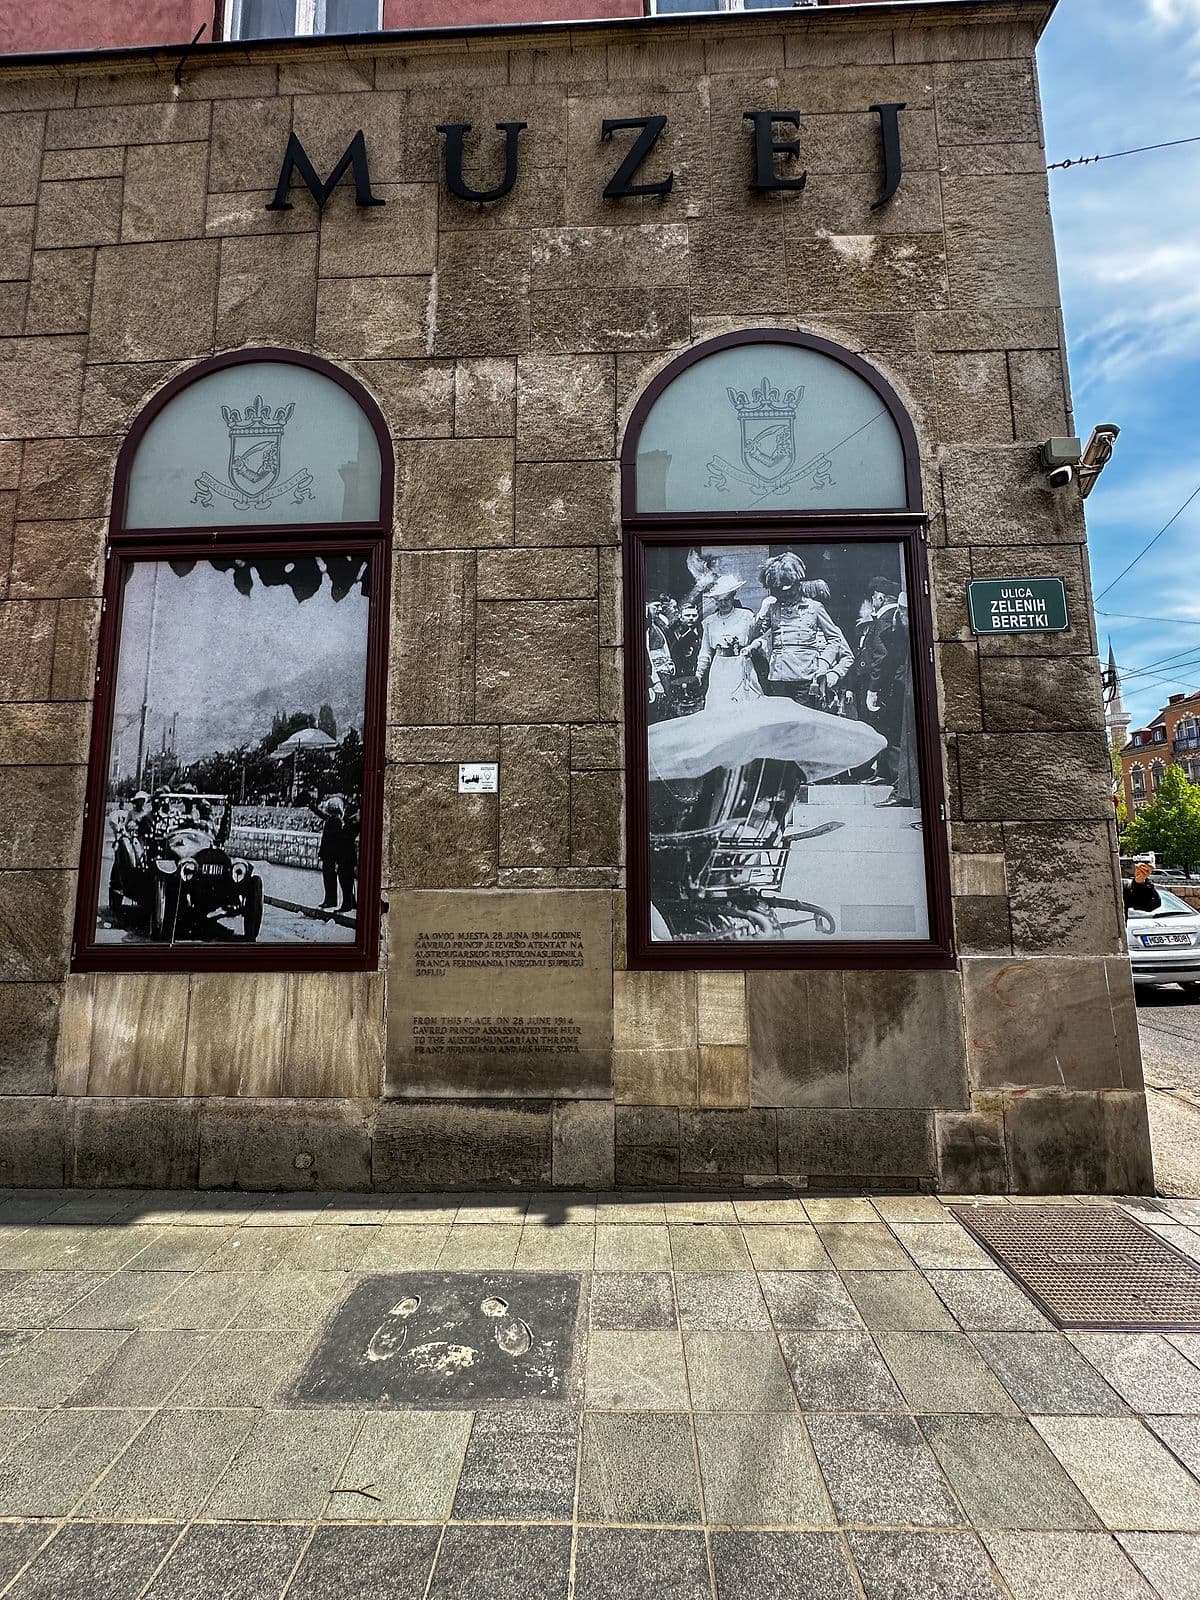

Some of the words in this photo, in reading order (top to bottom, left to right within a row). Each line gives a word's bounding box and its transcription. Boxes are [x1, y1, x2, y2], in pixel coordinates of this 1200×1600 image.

[265, 103, 906, 211] MUZEJ
[1001, 588, 1033, 598] ULICA
[990, 599, 1046, 612] ZELENIH
[991, 614, 1049, 628] BERETKI
[418, 932, 430, 940] SA
[432, 932, 455, 940] OVOG
[458, 932, 490, 940] MJESTA
[505, 932, 529, 940] JUNA
[552, 932, 581, 940] GODINE
[415, 941, 451, 949] GAVRILO
[453, 941, 483, 949] PRINCIP
[485, 941, 494, 949] JE
[528, 941, 567, 949] ATENTAT
[570, 941, 584, 949] NA
[415, 950, 490, 958] AUSTROUGARSKOG
[491, 950, 584, 958] PRESTOLONASLJEDNIKA
[416, 959, 450, 967] FRANCA
[452, 959, 504, 967] FERDINANDA
[510, 959, 546, 967] NJEGOVU
[548, 959, 584, 967] SUPRUGU
[413, 1017, 437, 1025] FROM
[440, 1017, 462, 1025] THIS
[464, 1017, 492, 1025] PLACE
[496, 1017, 510, 1025] ON
[513, 1017, 524, 1025] 28
[527, 1017, 551, 1025] JUNE
[555, 1017, 574, 1025] 1914
[413, 1027, 447, 1035] GAVRILO
[449, 1027, 480, 1035] PRINCIP
[482, 1027, 540, 1035] ASSASSINATED
[542, 1027, 559, 1035] THE
[560, 1027, 582, 1035] HEIR
[413, 1036, 425, 1045] TO
[427, 1036, 445, 1045] THE
[540, 1036, 579, 1045] THRONE
[414, 1045, 444, 1054] FRANZ
[447, 1045, 496, 1054] FERDINAND
[499, 1045, 517, 1054] AND
[519, 1045, 533, 1054] HIS
[535, 1045, 555, 1054] WIFE
